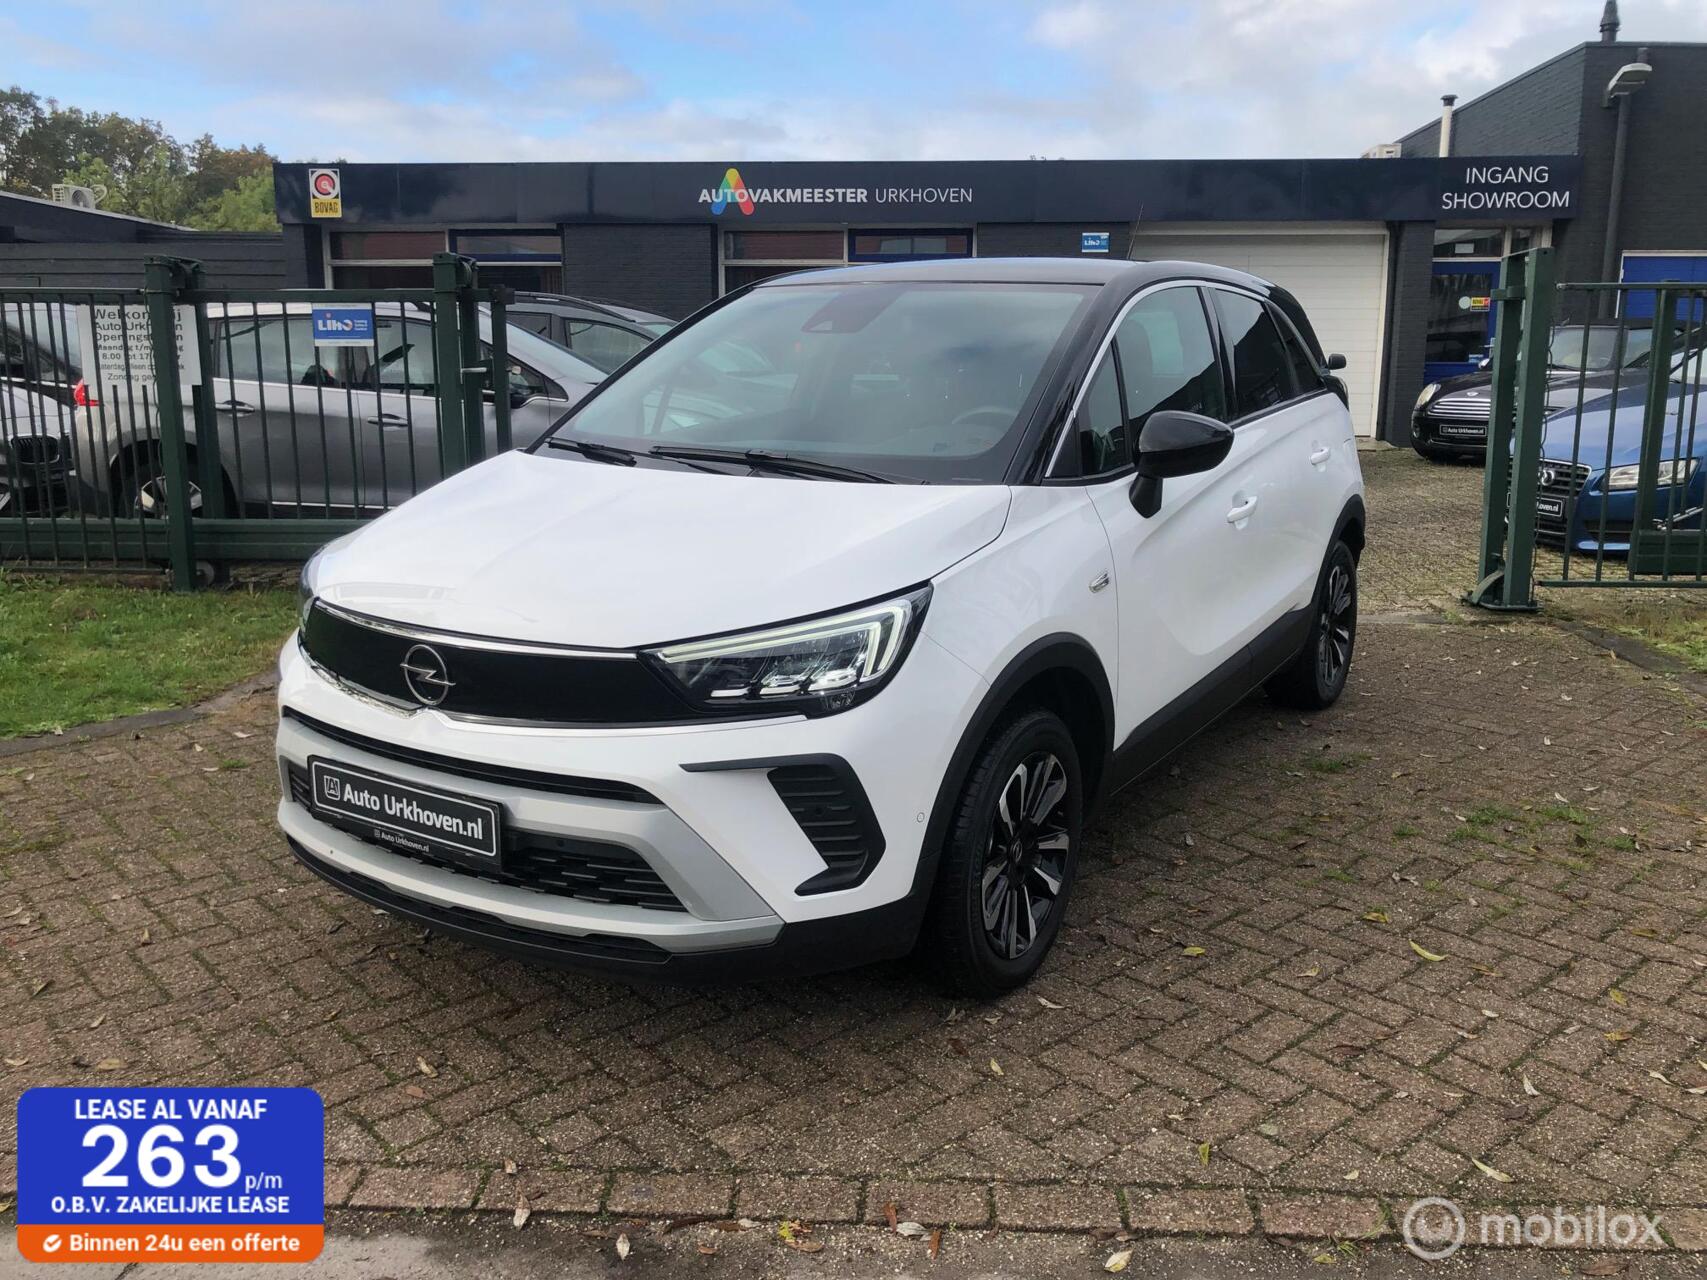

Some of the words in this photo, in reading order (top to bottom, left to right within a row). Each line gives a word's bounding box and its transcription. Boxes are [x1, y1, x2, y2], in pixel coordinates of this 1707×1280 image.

[1466, 166, 1549, 184] INGANG
[699, 188, 868, 203] AUTOVAKMEESTER
[875, 187, 973, 203] URKHOVEN
[1442, 191, 1570, 209] SHOWROOM
[314, 201, 339, 214] BOVAG
[343, 783, 380, 811] Auto
[384, 794, 483, 840] Urkhoven.nl
[381, 831, 395, 842] Auto
[395, 836, 430, 852] Urkhoven.nl
